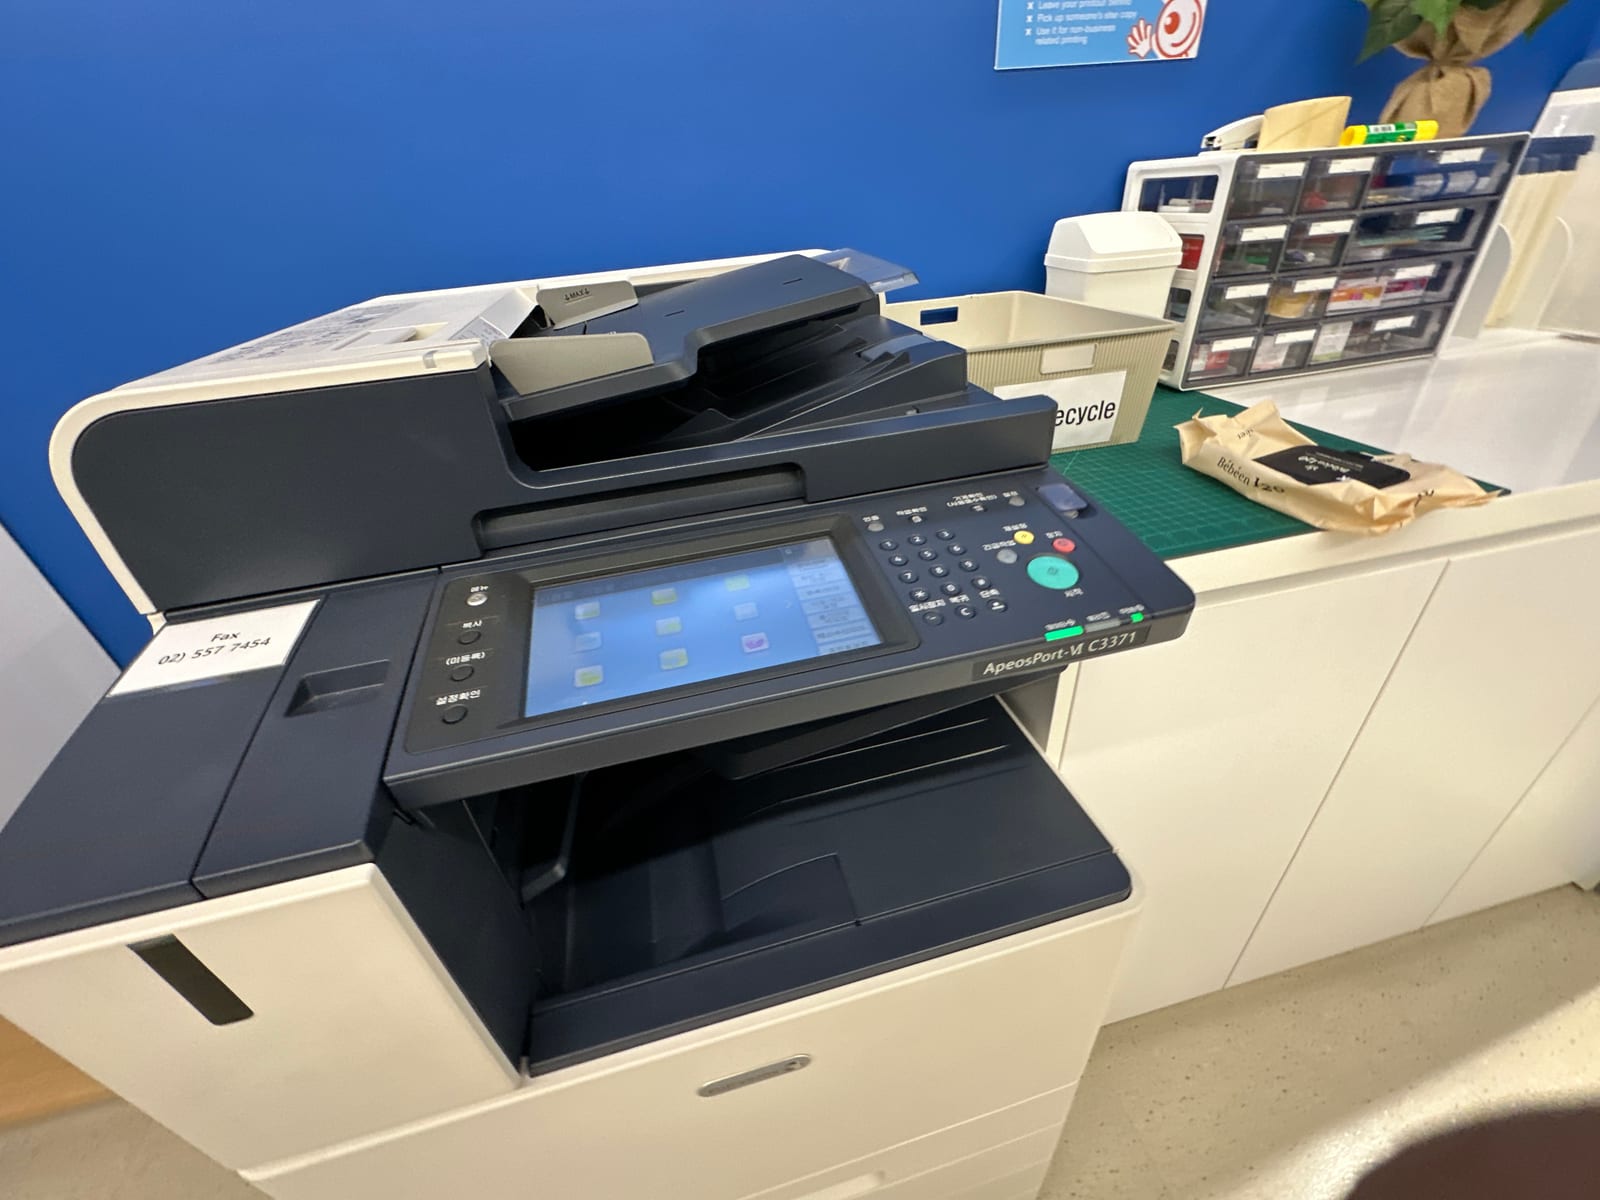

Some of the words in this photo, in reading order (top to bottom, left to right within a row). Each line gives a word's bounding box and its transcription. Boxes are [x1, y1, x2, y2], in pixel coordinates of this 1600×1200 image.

[570, 289, 585, 299] MAX
[1055, 400, 1116, 426] ecycle
[210, 632, 241, 642] Fax
[1087, 631, 1137, 652] C3371
[158, 652, 186, 665] 02)
[191, 645, 226, 659] 557
[230, 637, 271, 652] 7454
[435, 690, 481, 706] 설정확인
